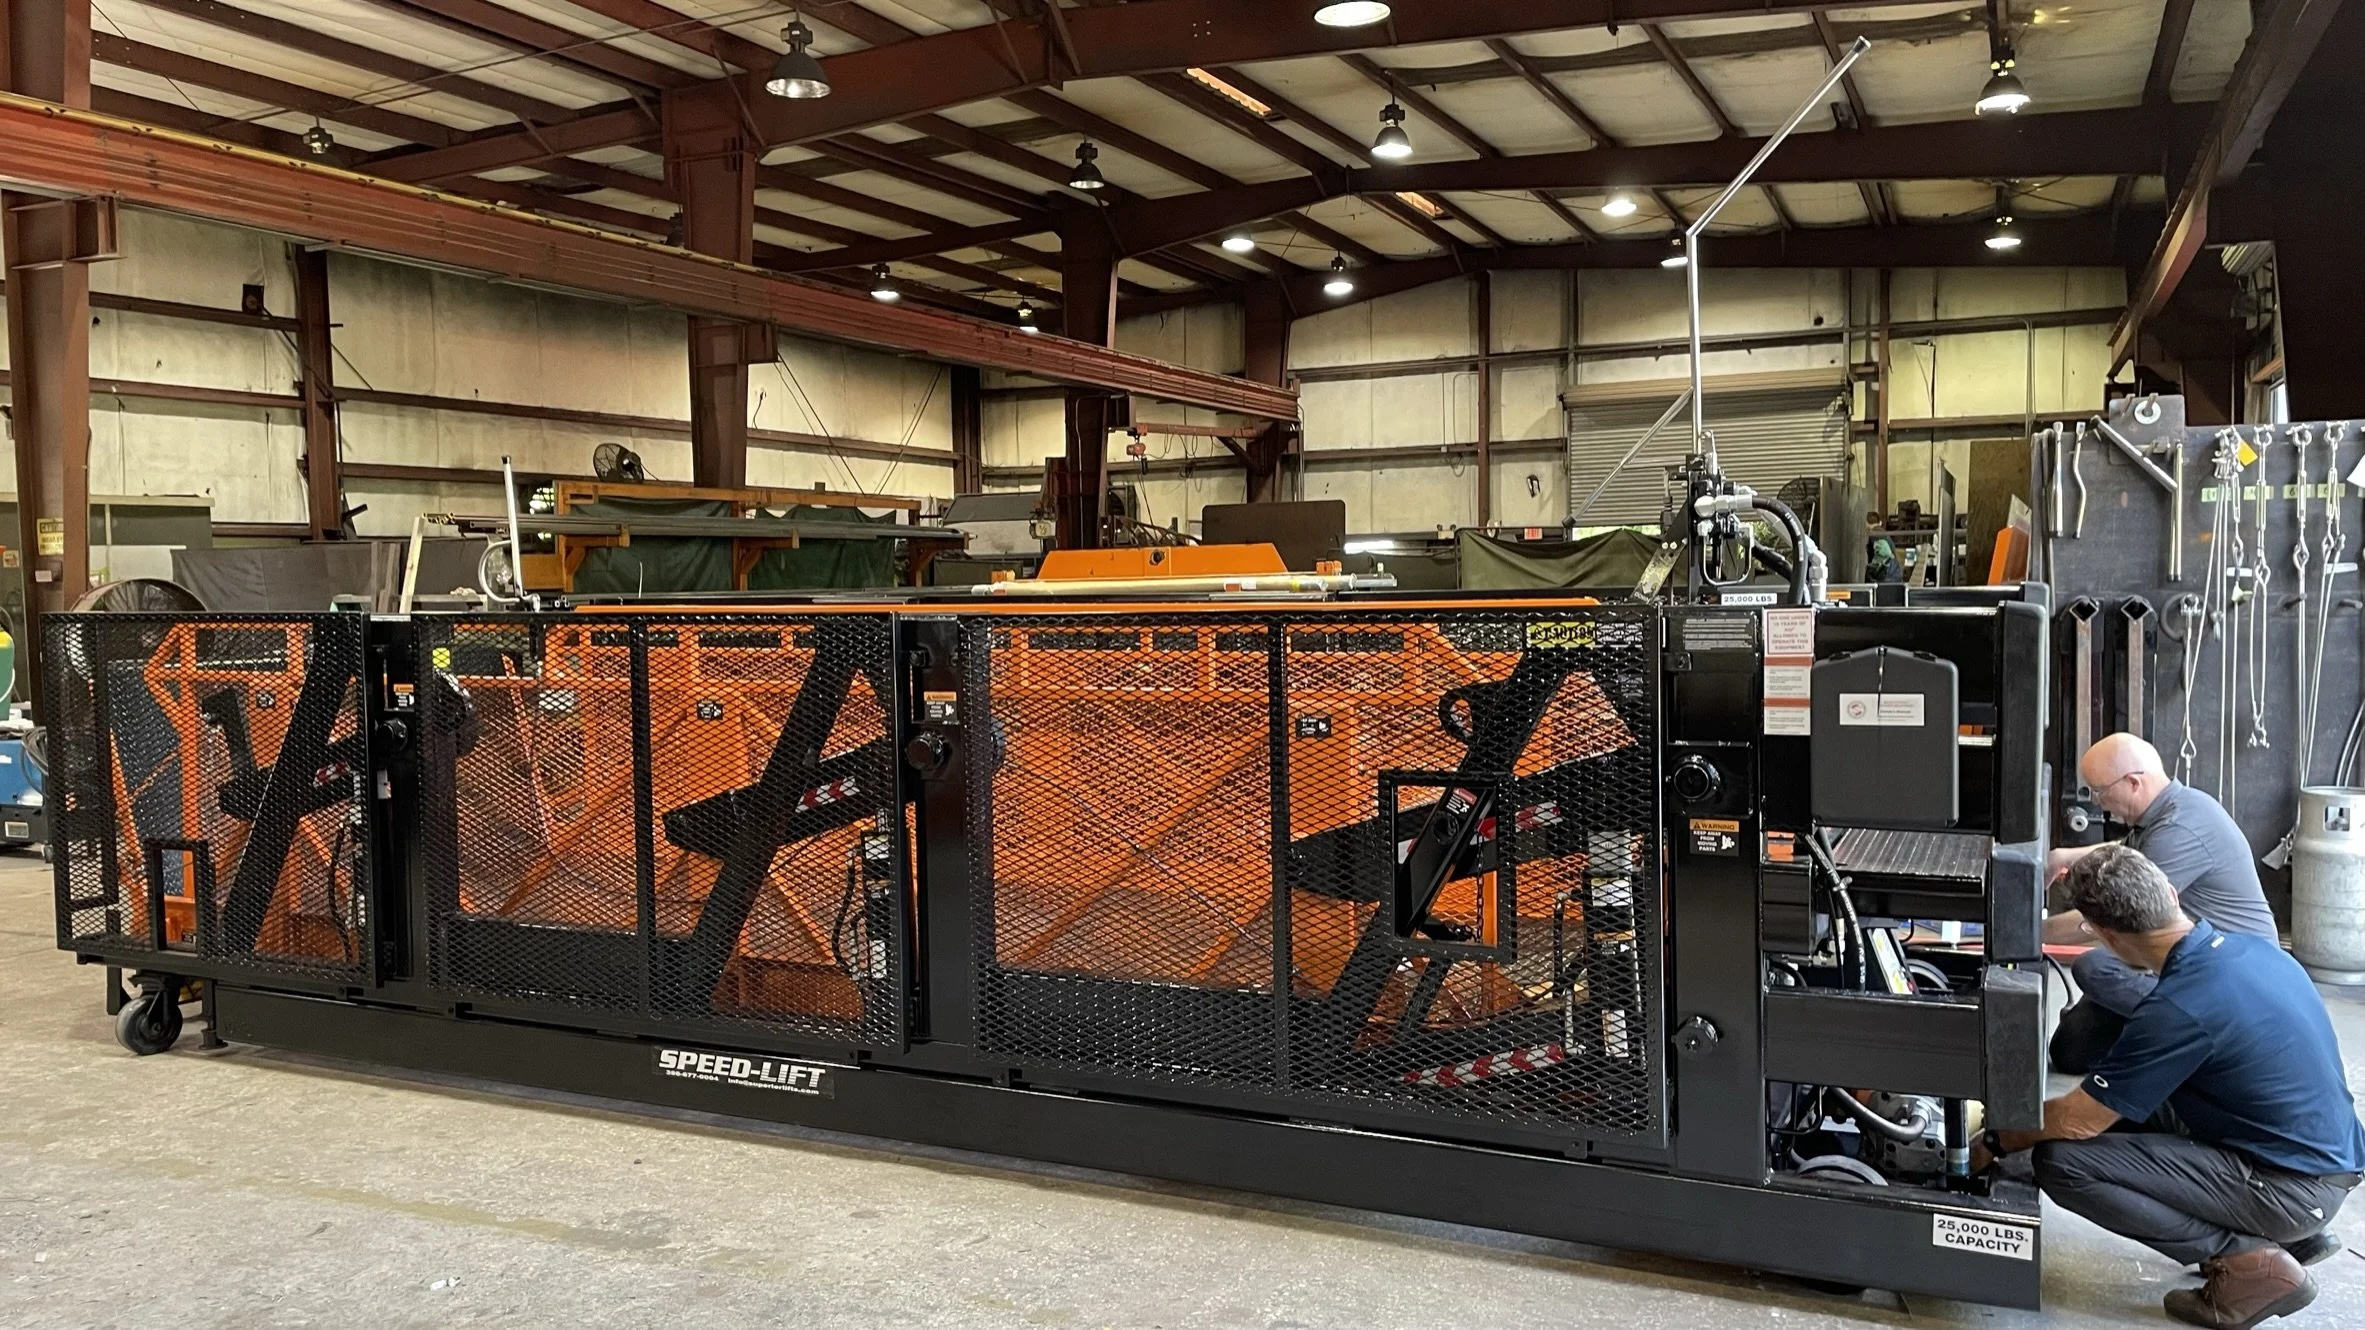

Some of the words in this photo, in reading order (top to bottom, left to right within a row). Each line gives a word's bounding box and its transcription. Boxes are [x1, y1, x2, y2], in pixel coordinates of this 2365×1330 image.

[659, 1049, 826, 1088] SPEED-LIFT
[1937, 1220, 1989, 1235] 25,000
[1995, 1228, 2029, 1242] LBS.
[1945, 1233, 2020, 1253] CAPACITY
